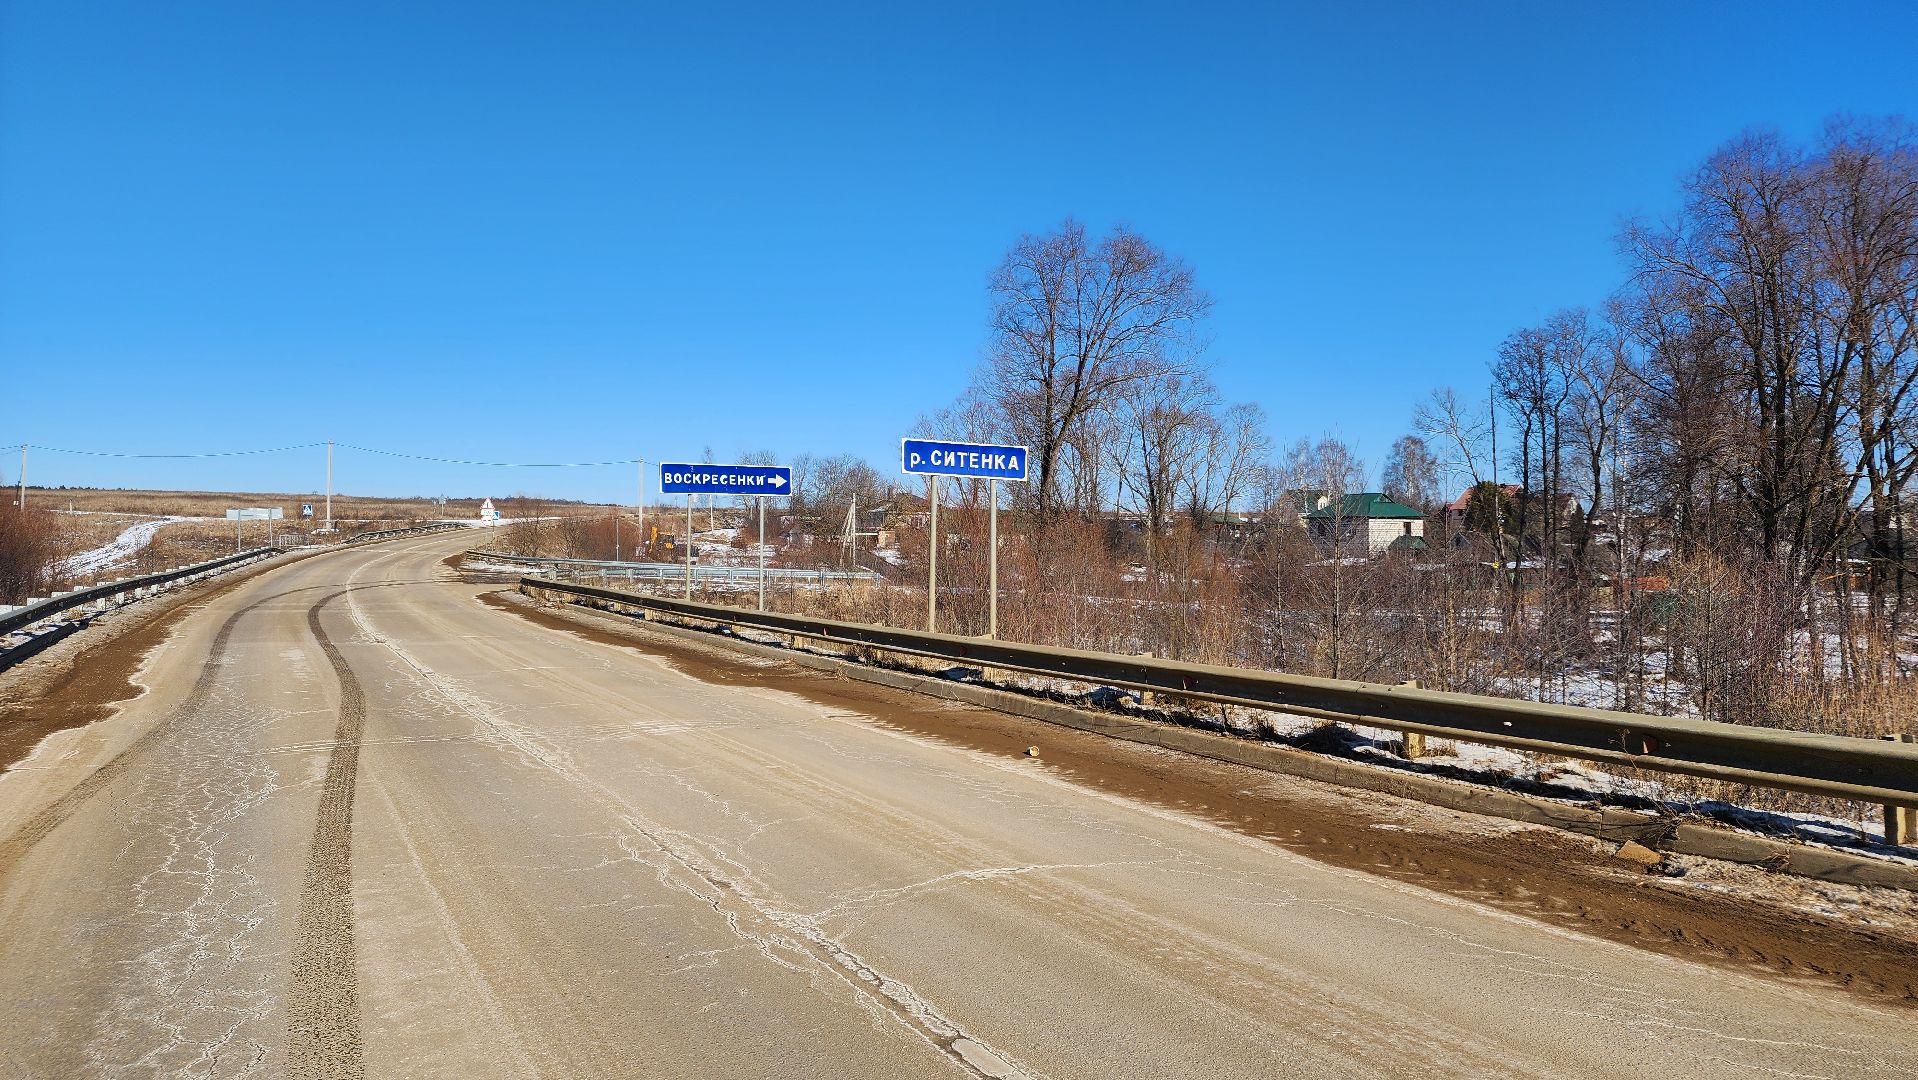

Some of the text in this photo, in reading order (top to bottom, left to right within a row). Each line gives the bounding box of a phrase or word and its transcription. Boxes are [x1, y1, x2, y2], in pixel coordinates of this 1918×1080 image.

[910, 449, 1019, 471] р. СИТЕНКА
[664, 472, 764, 486] ВОСКРЕСЕНКИ
